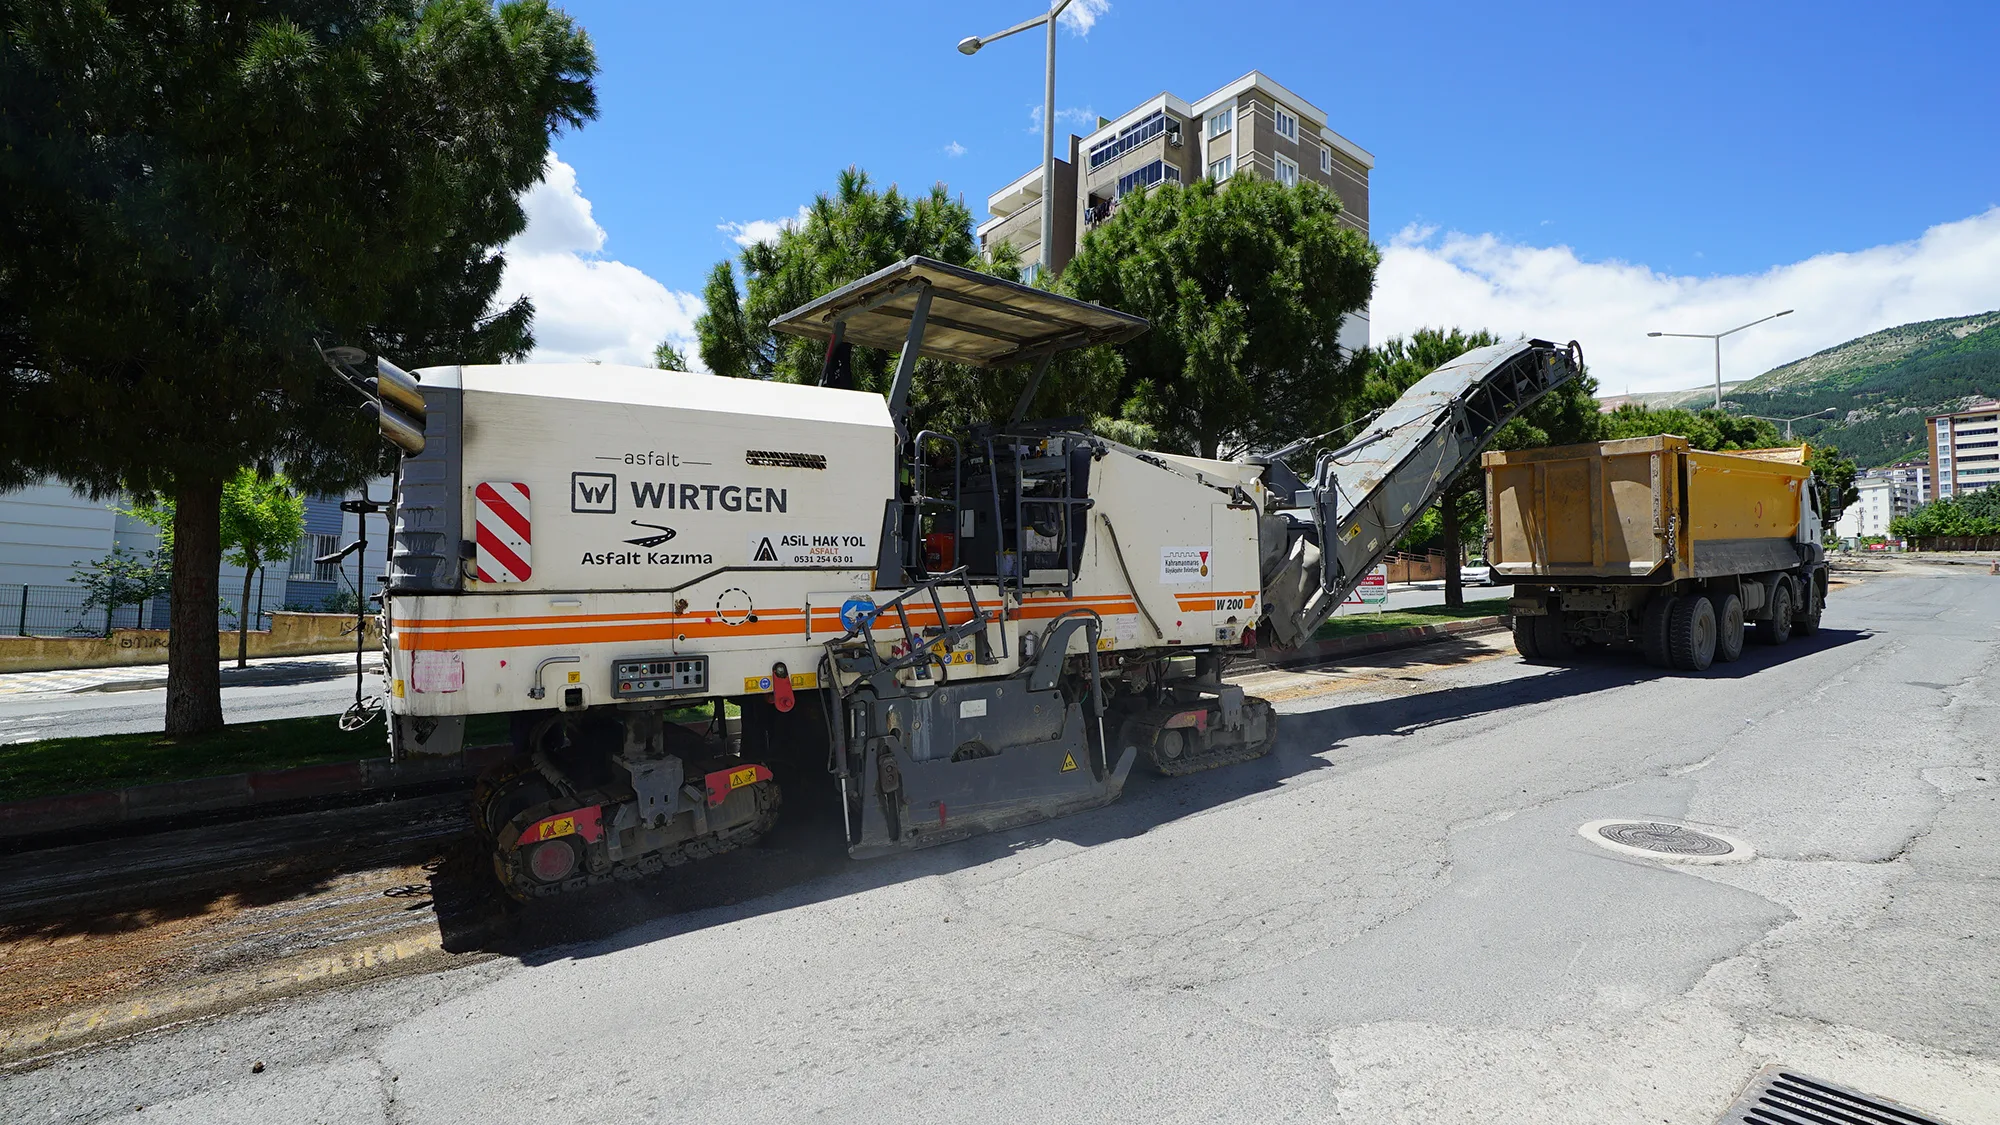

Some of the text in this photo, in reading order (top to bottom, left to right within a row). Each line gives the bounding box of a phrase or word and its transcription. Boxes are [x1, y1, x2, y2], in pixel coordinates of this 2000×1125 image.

[624, 451, 680, 467] asfalt
[630, 481, 787, 513] WIRTGEN
[813, 536, 838, 546] HAK
[842, 536, 865, 546] YOL
[809, 547, 839, 555] ASFALT
[581, 552, 641, 565] Asfalt
[794, 555, 853, 563] 0531 254 63 01
[1216, 599, 1243, 610] W 200
